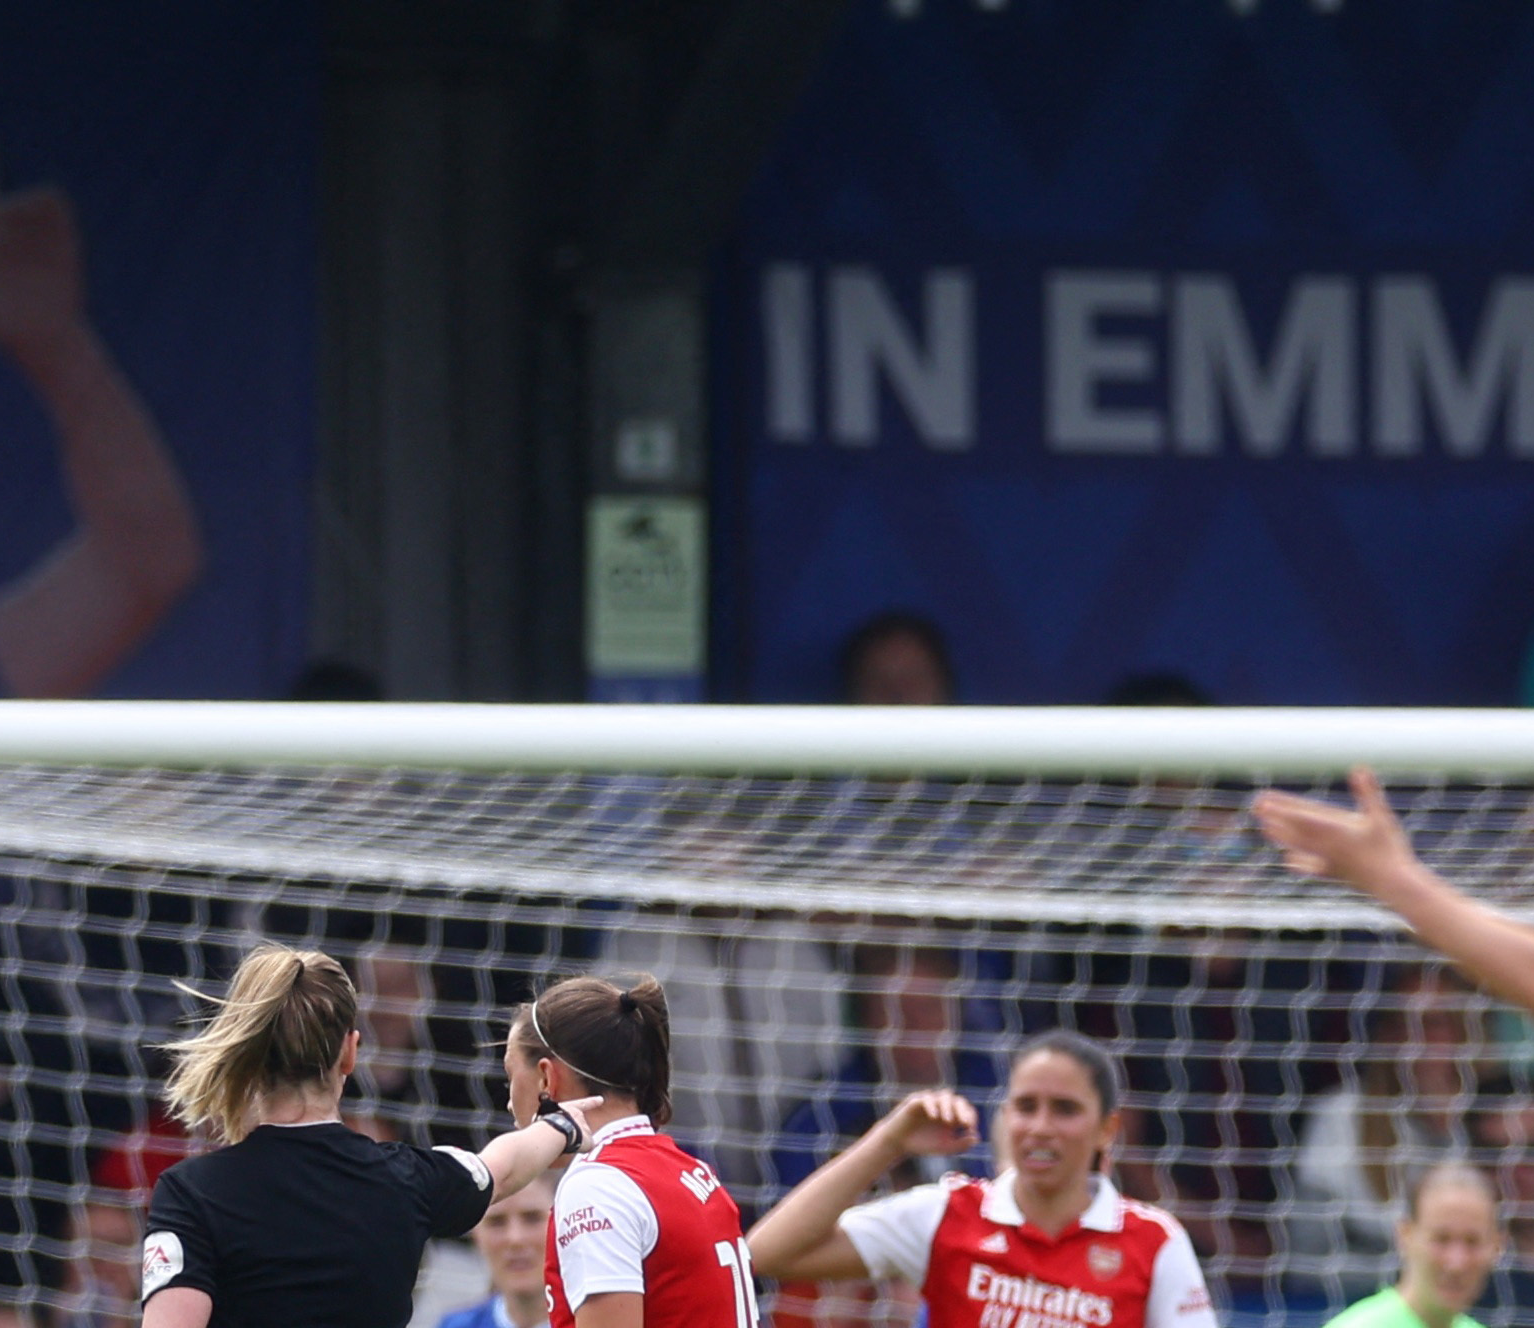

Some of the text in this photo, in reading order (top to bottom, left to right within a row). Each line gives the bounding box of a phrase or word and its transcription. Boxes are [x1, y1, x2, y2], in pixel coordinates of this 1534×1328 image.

[766, 262, 975, 450] IN
[557, 1217, 613, 1249] RWANDA
[562, 1206, 595, 1227] VISIT
[967, 1262, 1113, 1326] Emirates
